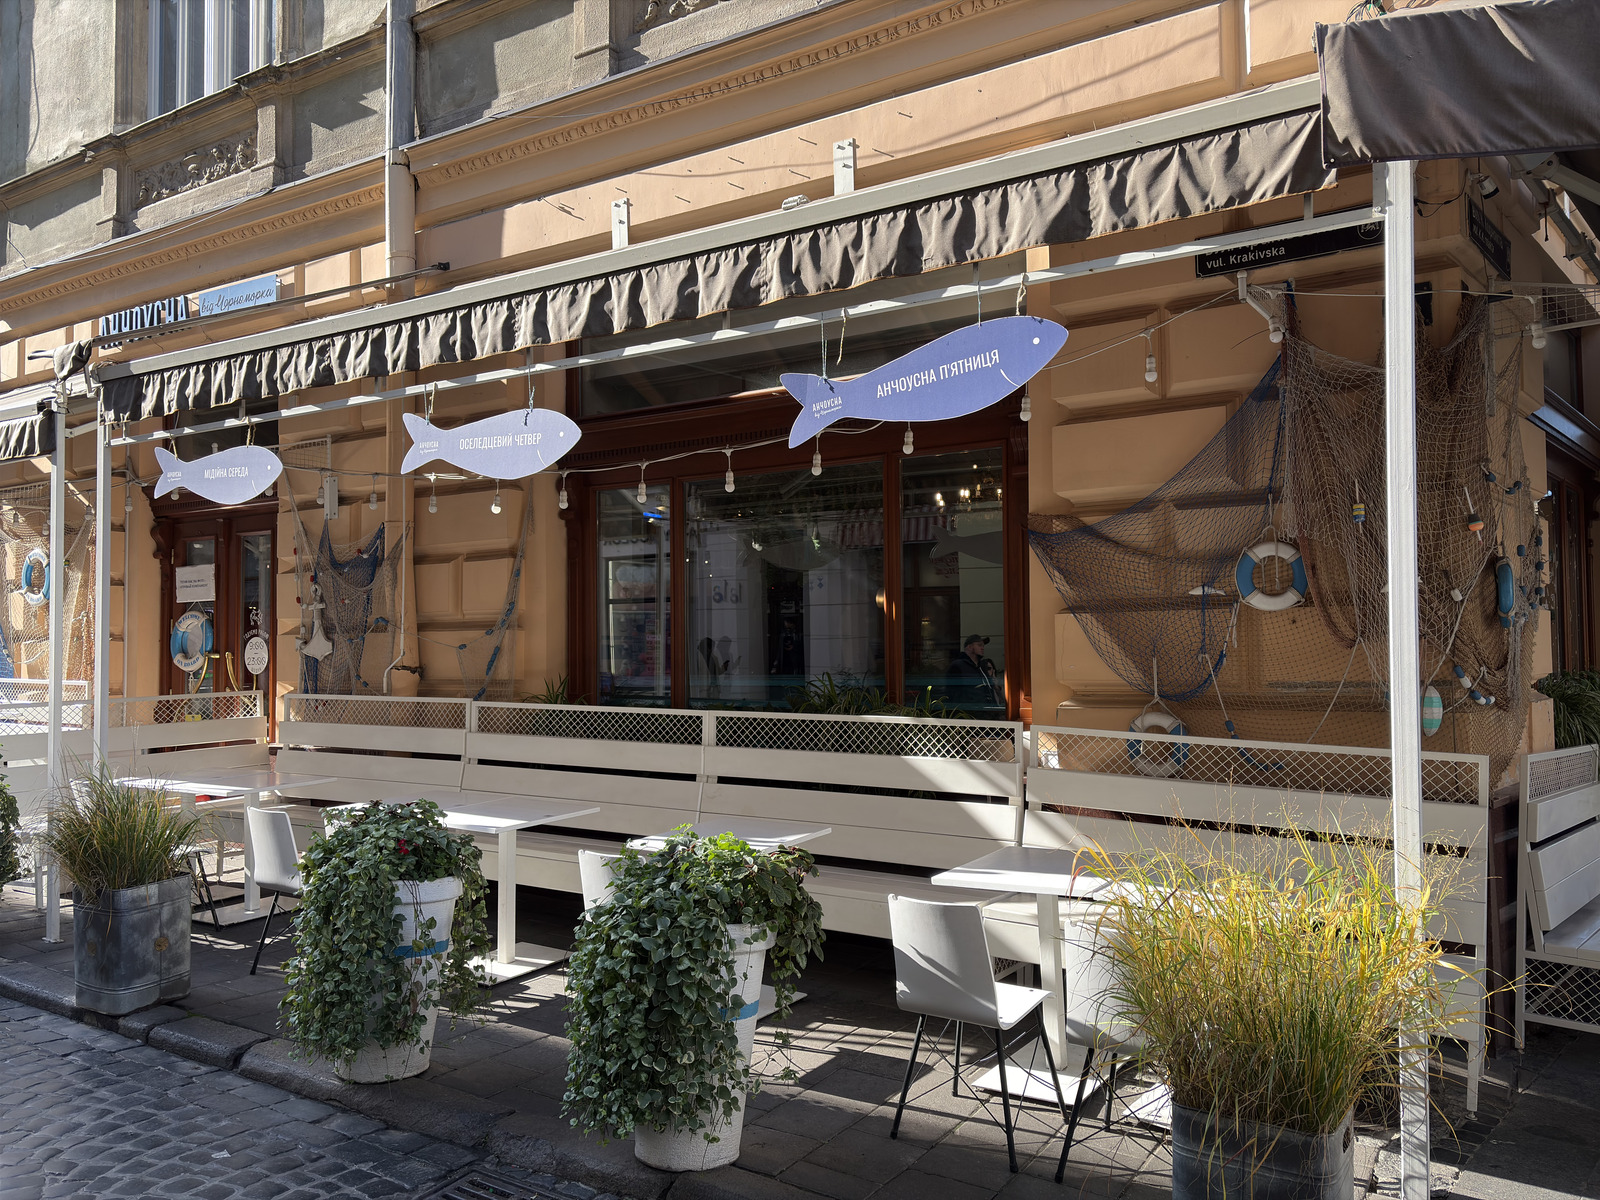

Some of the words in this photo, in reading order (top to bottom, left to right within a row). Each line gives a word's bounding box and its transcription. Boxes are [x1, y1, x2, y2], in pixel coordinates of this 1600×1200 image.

[1206, 257, 1226, 269] vul.
[1229, 246, 1286, 265] Krakivska
[876, 368, 937, 398] АНЧОУСНА
[939, 349, 1000, 380] П'ЯТНИЦЯ
[812, 396, 842, 412] АНЧОУСНА
[459, 433, 512, 450] ОСЕЛЕДЦЕВИЙ
[514, 433, 542, 446] ЧЕТВЕР
[228, 466, 249, 478] СЕРЕДА
[178, 613, 201, 626] WELCOME
[249, 641, 264, 651] 9:00
[183, 656, 200, 668] BOARD
[247, 656, 266, 666] 23:00
